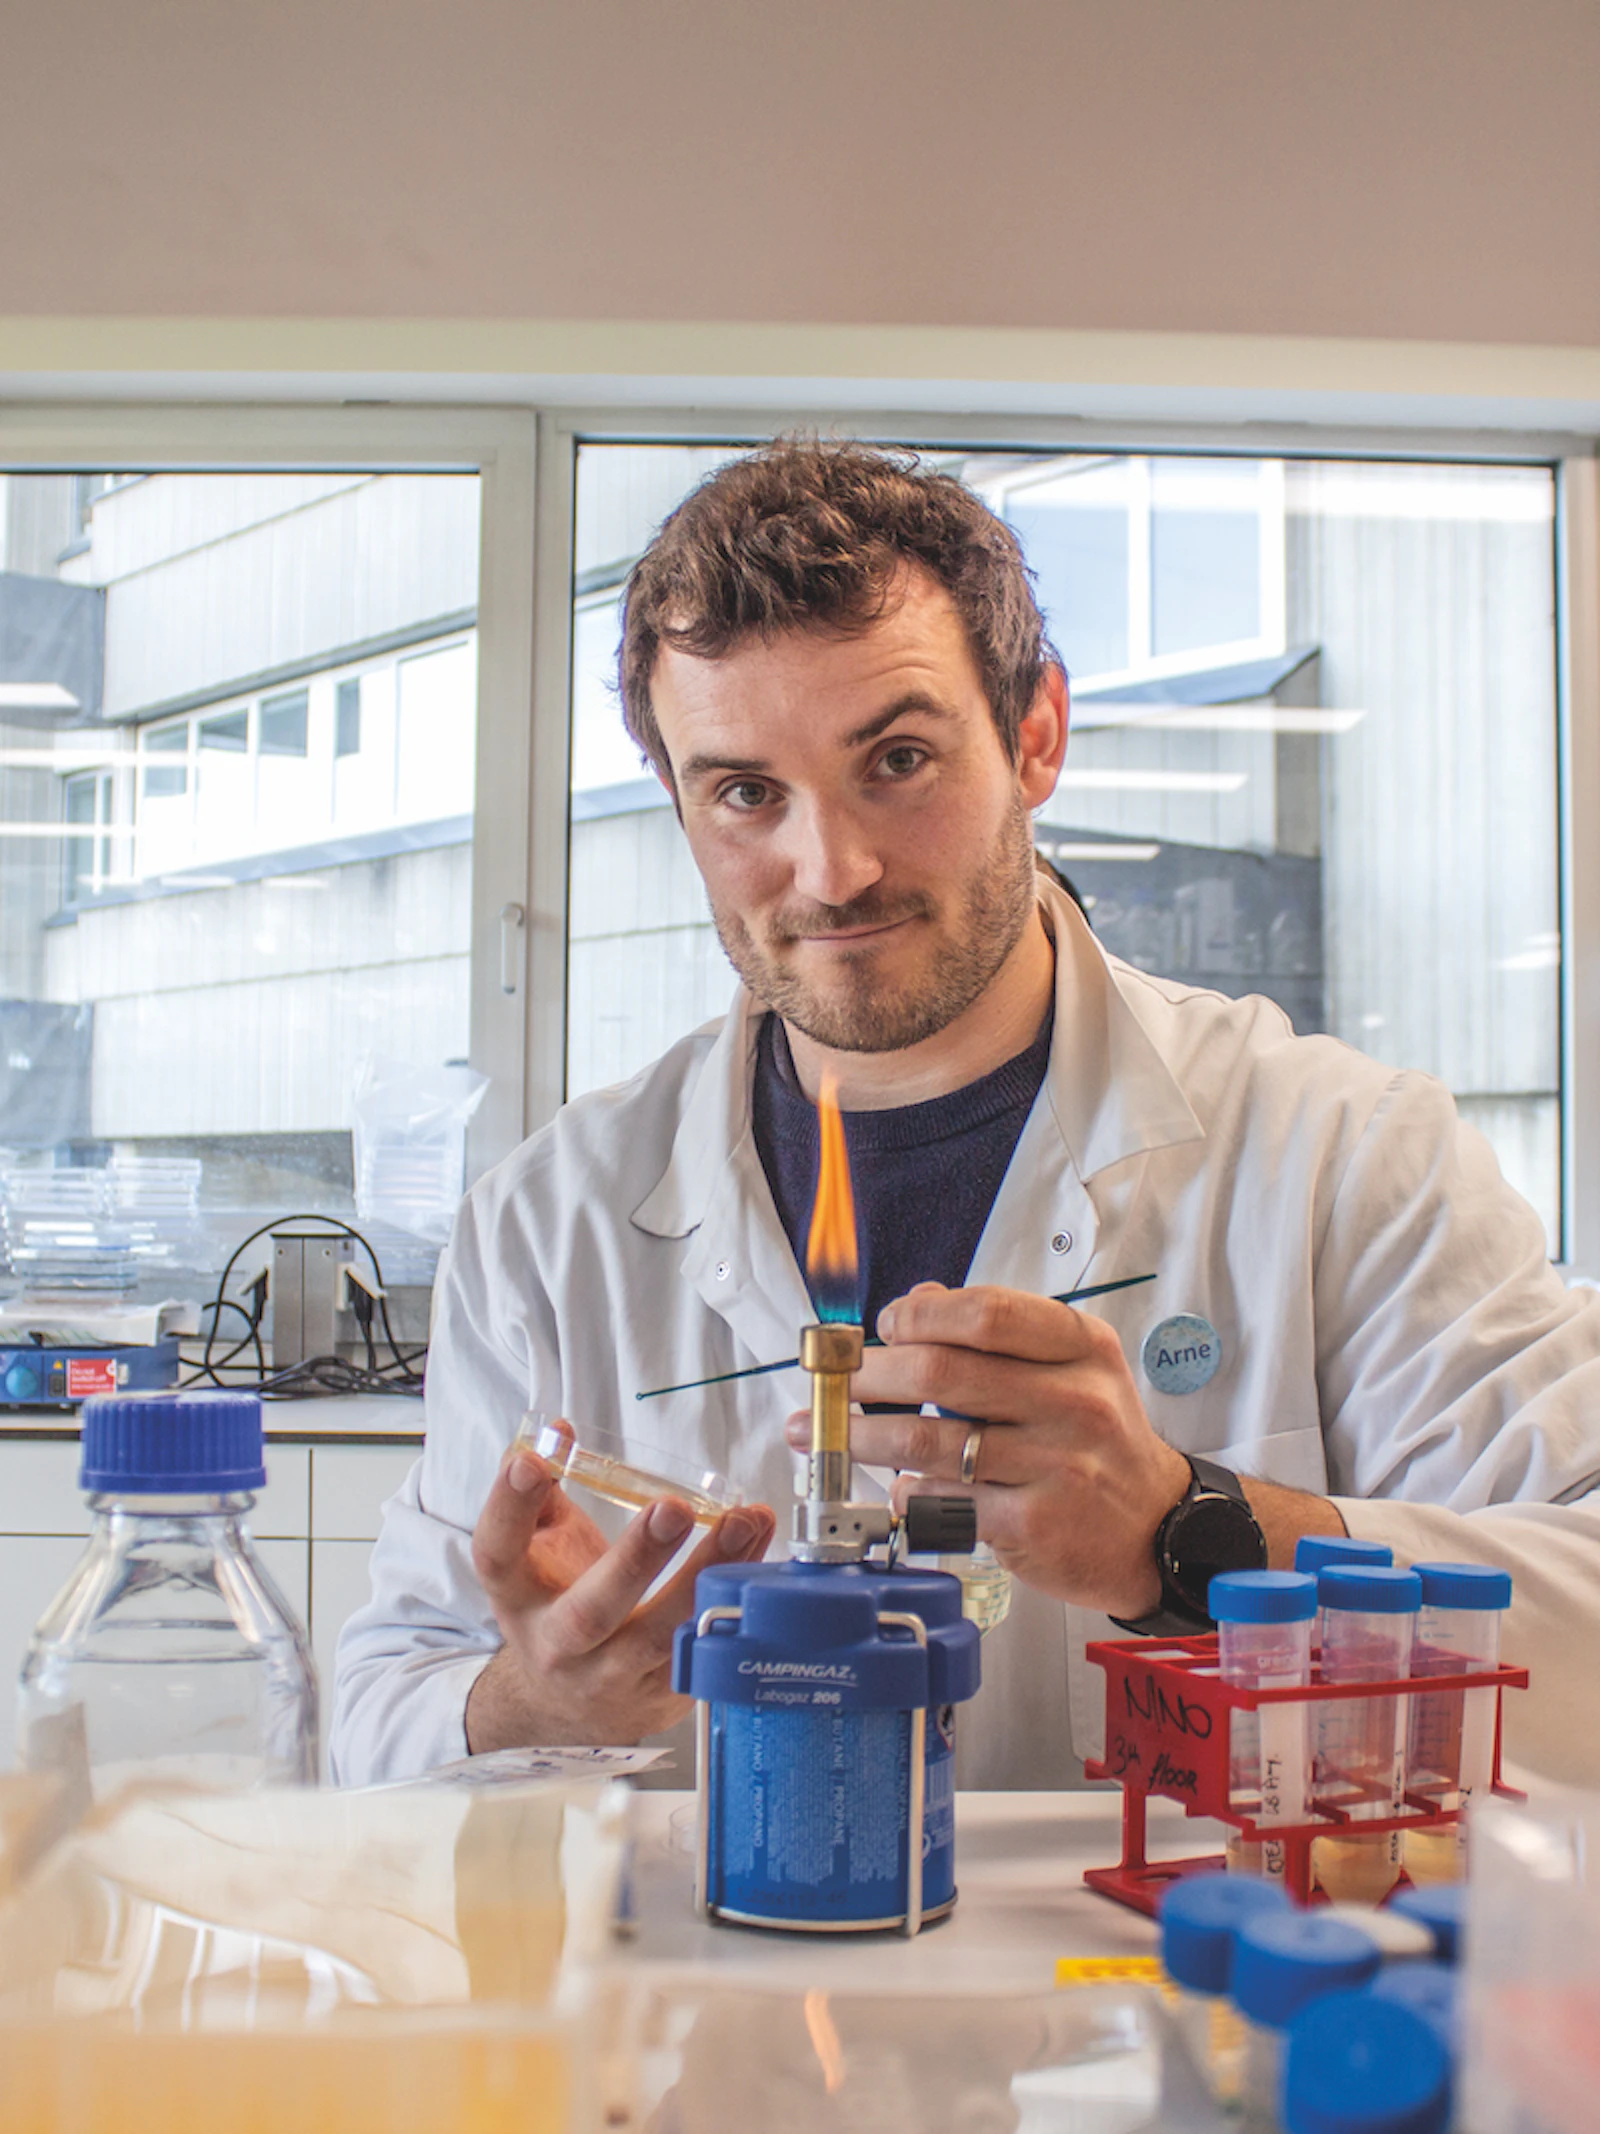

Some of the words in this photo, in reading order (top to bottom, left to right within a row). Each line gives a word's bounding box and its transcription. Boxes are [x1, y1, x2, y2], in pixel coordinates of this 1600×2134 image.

[1156, 1343, 1211, 1369] Arne
[737, 1660, 851, 1679] CAMPINGAZ
[754, 1687, 810, 1706] Labogaz
[812, 1690, 842, 1705] 206
[1123, 1675, 1213, 1739] NINO
[753, 1785, 764, 1848] PROPANO
